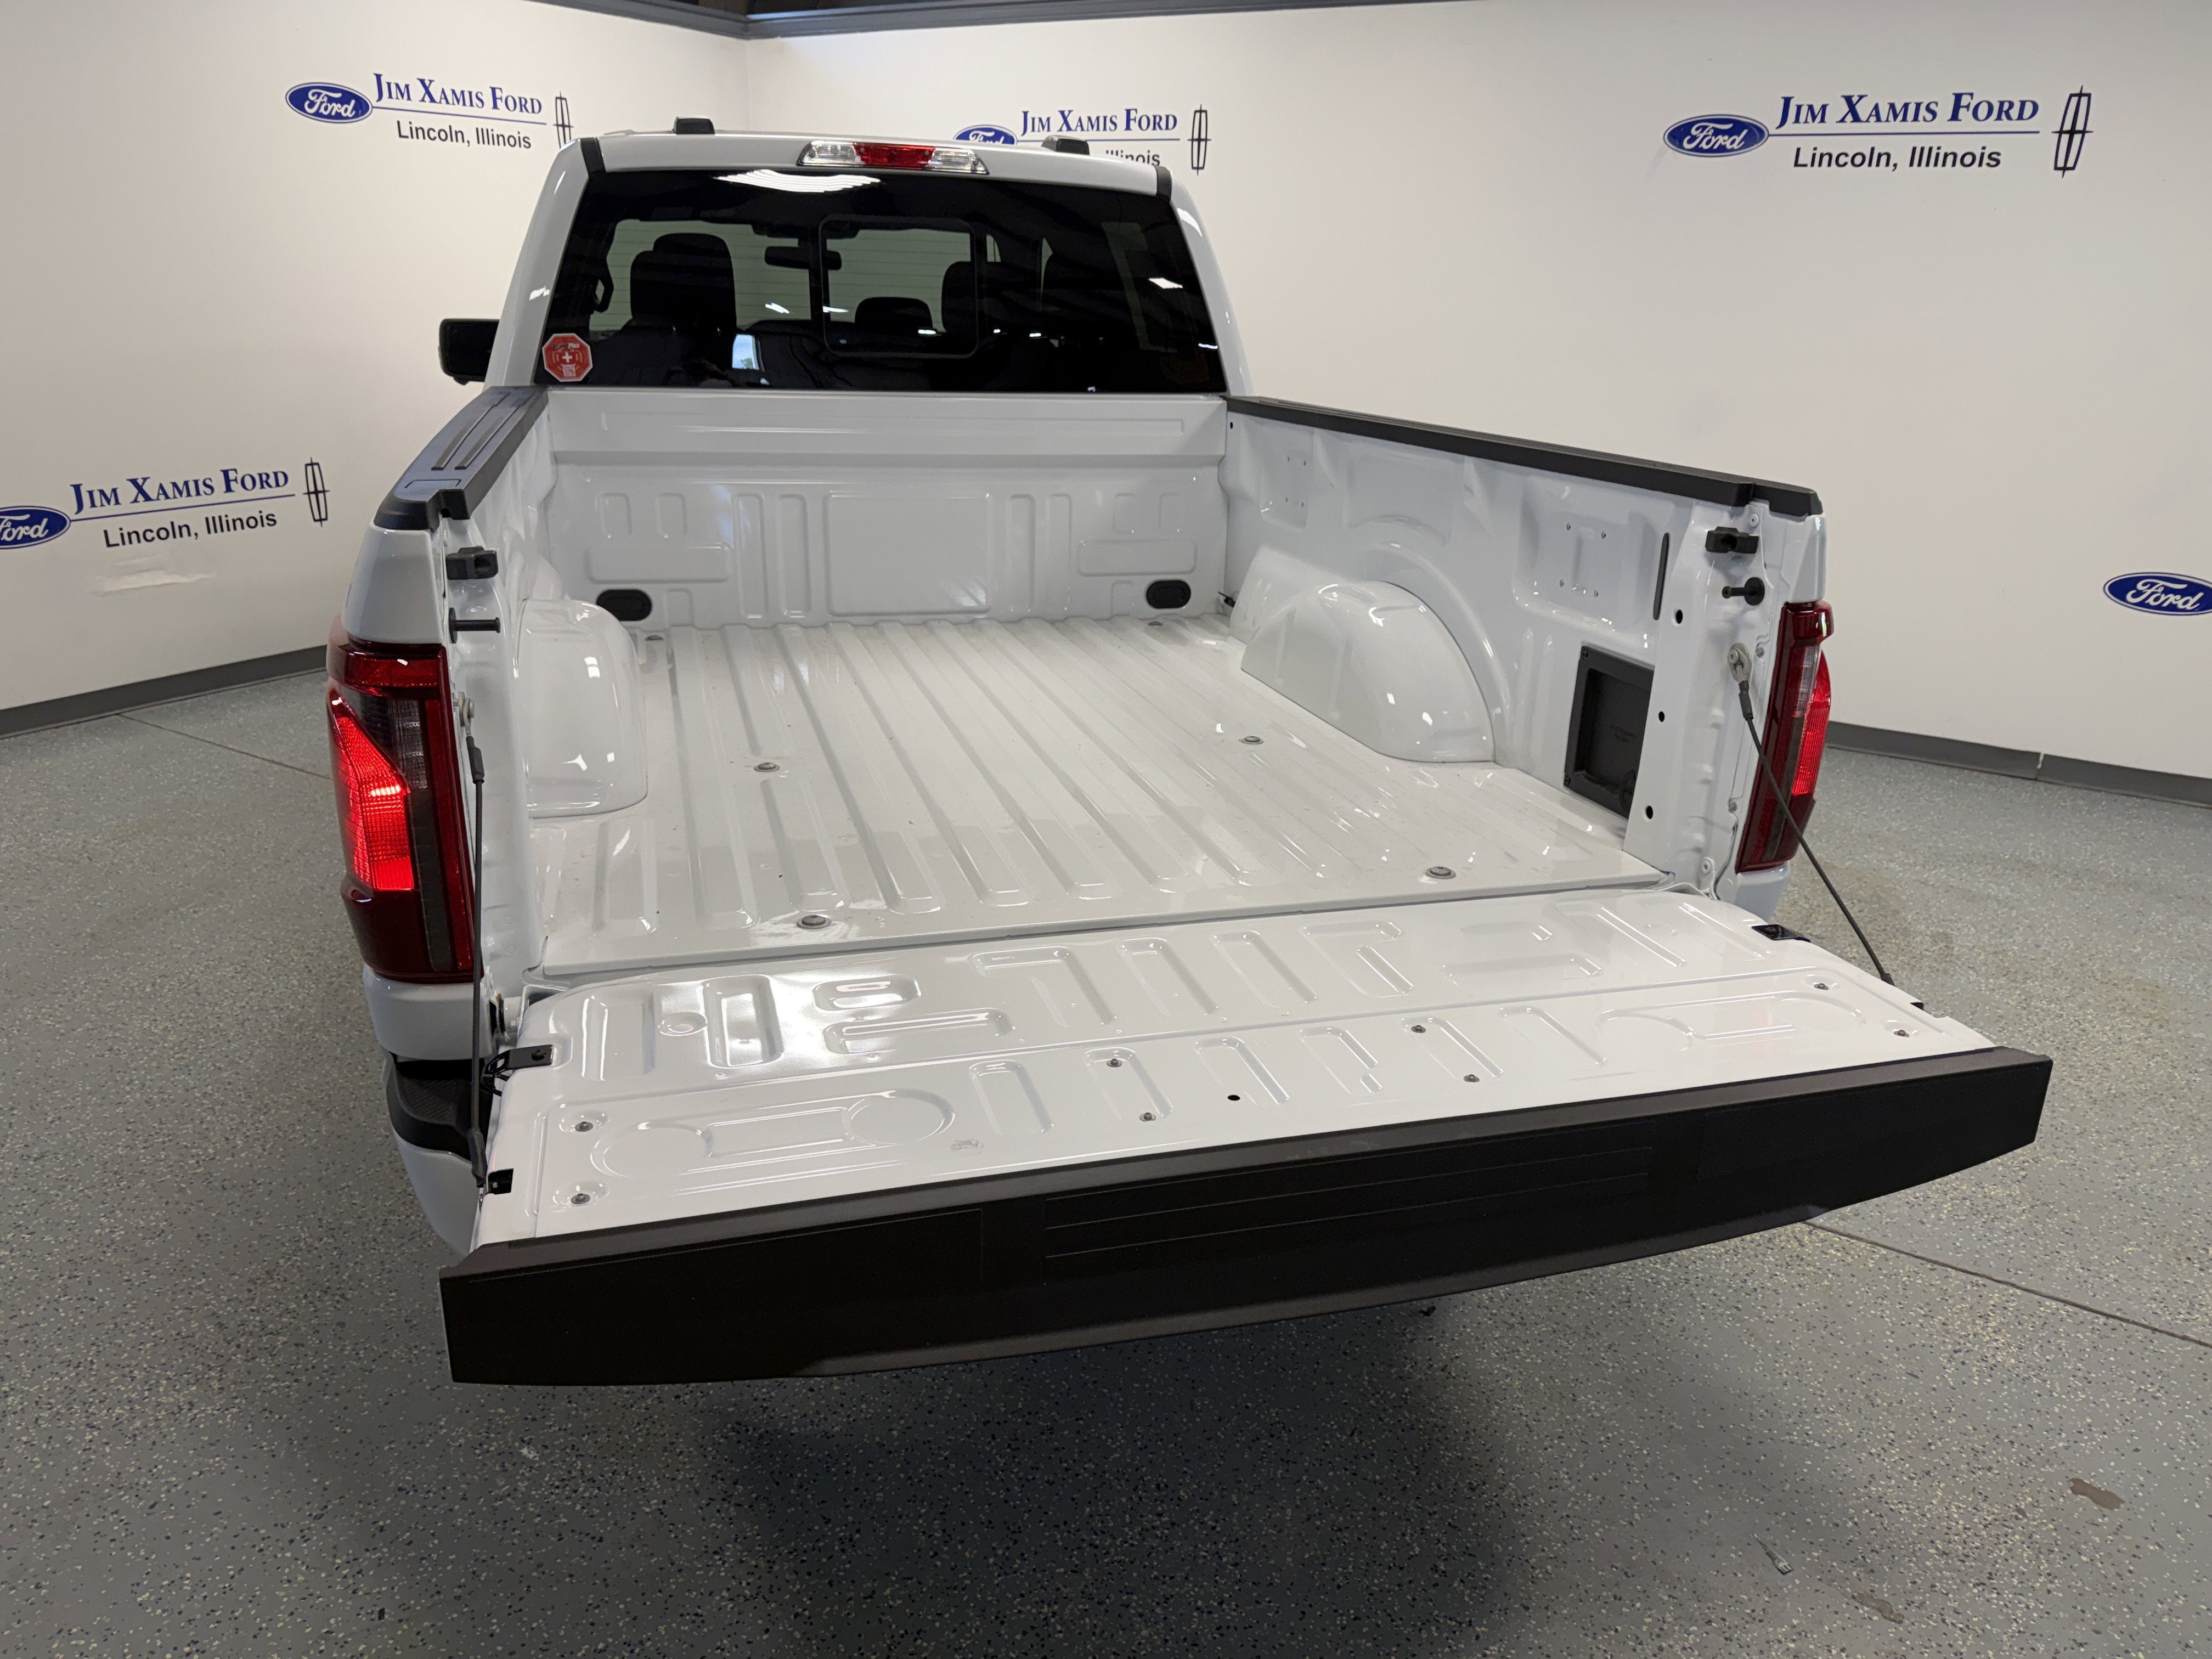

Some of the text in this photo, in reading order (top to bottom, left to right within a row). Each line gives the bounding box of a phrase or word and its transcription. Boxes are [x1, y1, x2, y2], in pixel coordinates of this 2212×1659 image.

[304, 89, 356, 118] Ford
[373, 73, 543, 114] JIM XAMIS FORD
[1021, 108, 1177, 137] JIM XAMIS FORD
[1775, 92, 2039, 129] JIM XAMIS FORD
[397, 120, 532, 149] Lincoln, Illinois
[1683, 122, 1746, 150] Ford
[1793, 146, 2001, 172] Lincoln, Illinois
[70, 468, 289, 515] JIM XAMIS FORD
[103, 510, 277, 548] Lincoln, Illinois
[2126, 578, 2204, 610] Ford
